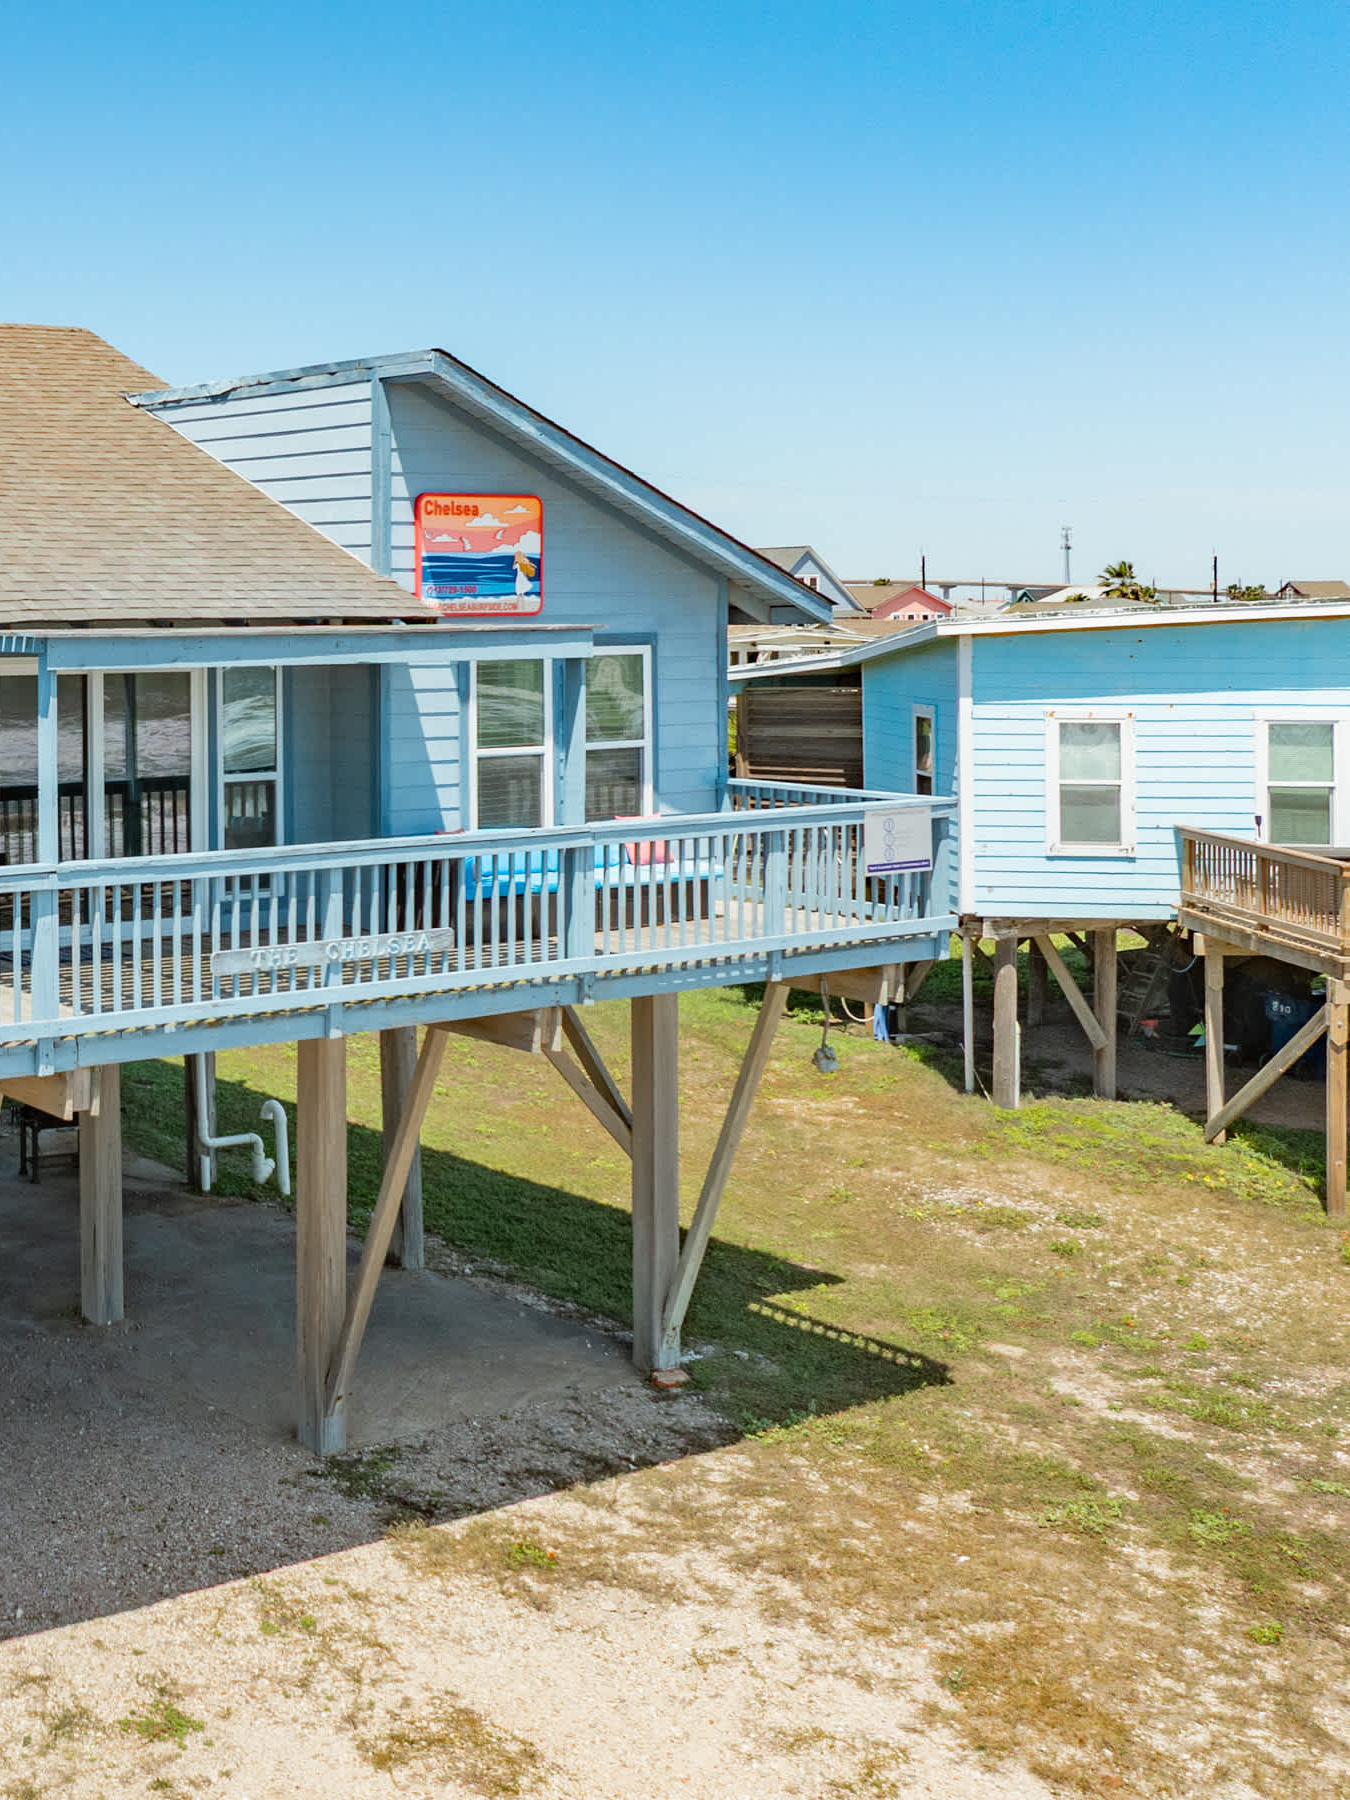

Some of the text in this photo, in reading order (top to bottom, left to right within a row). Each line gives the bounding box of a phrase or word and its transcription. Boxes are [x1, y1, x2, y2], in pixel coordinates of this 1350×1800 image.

[424, 500, 479, 516] Chelsea
[250, 933, 433, 970] THE CHELSEA
